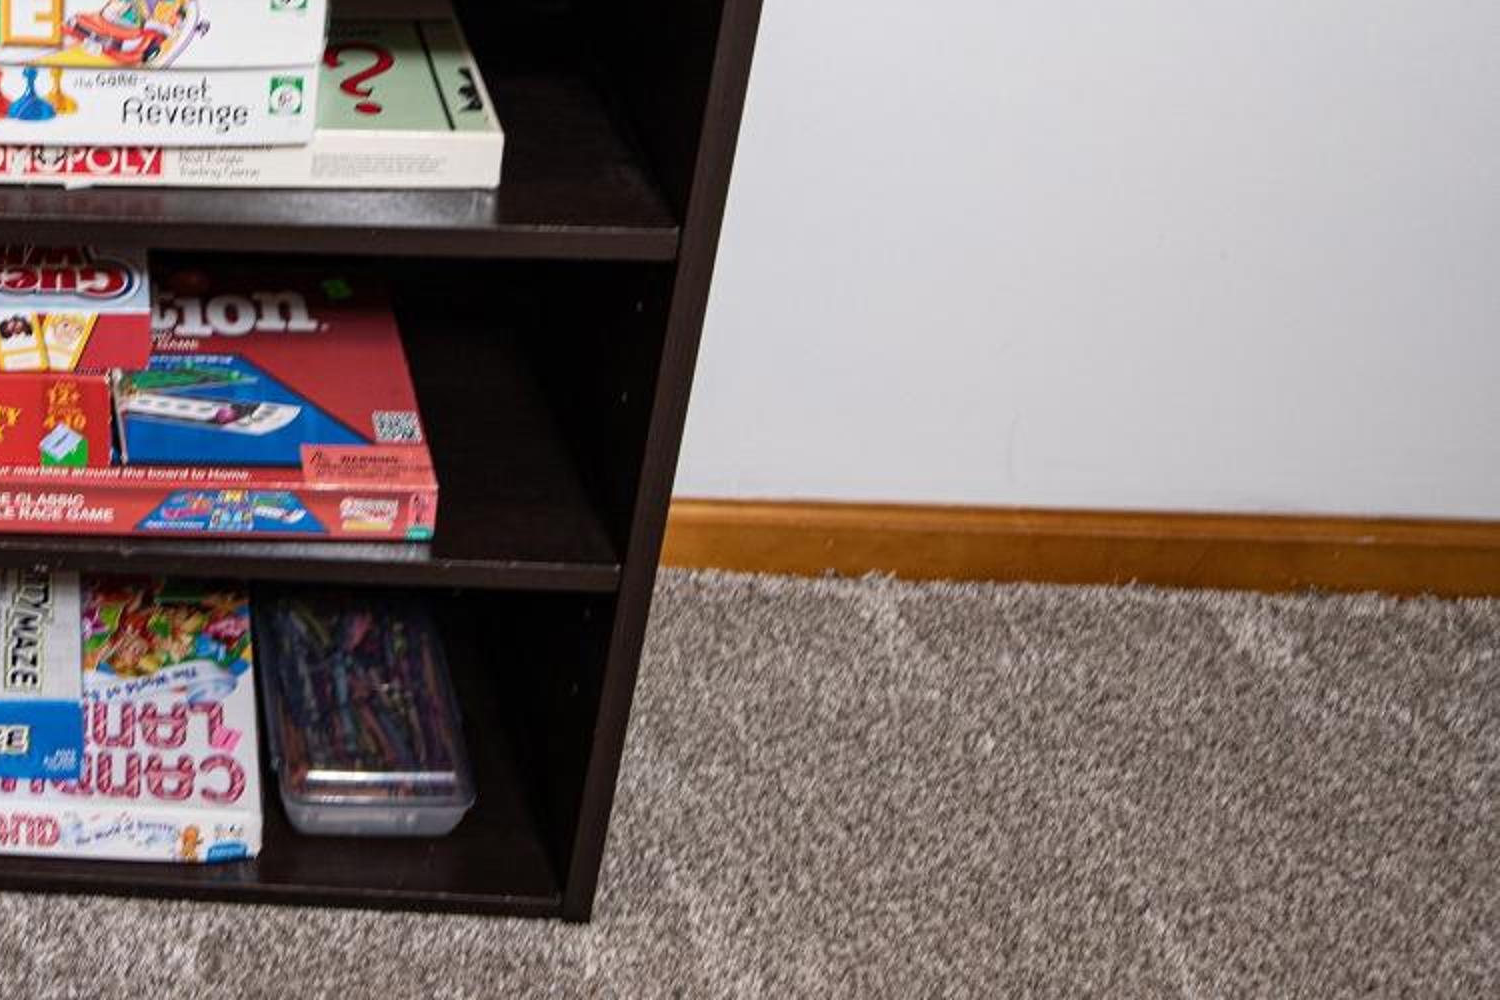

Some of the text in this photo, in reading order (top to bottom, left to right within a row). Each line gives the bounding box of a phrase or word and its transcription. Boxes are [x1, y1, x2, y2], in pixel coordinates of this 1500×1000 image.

[121, 96, 250, 133] Revenge
[14, 493, 85, 508] CLASSIC
[19, 507, 63, 521] RACE
[66, 507, 115, 522] GAME
[84, 701, 224, 749] LAN
